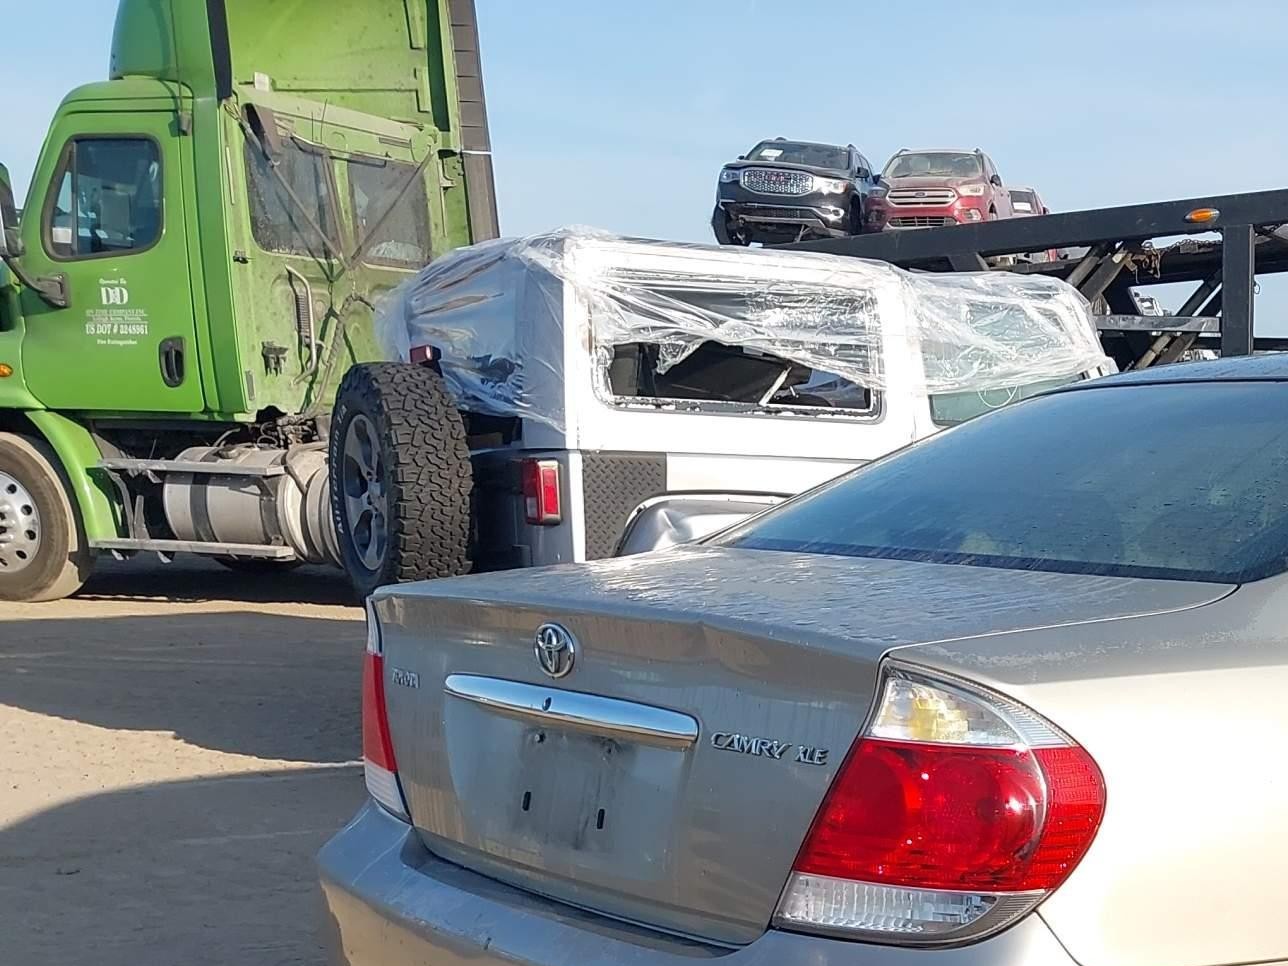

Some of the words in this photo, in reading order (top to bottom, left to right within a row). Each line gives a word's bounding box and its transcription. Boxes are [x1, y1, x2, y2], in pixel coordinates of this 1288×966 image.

[96, 324, 112, 335] DOT
[711, 731, 792, 760] CAMRY
[794, 746, 829, 765] XLE
